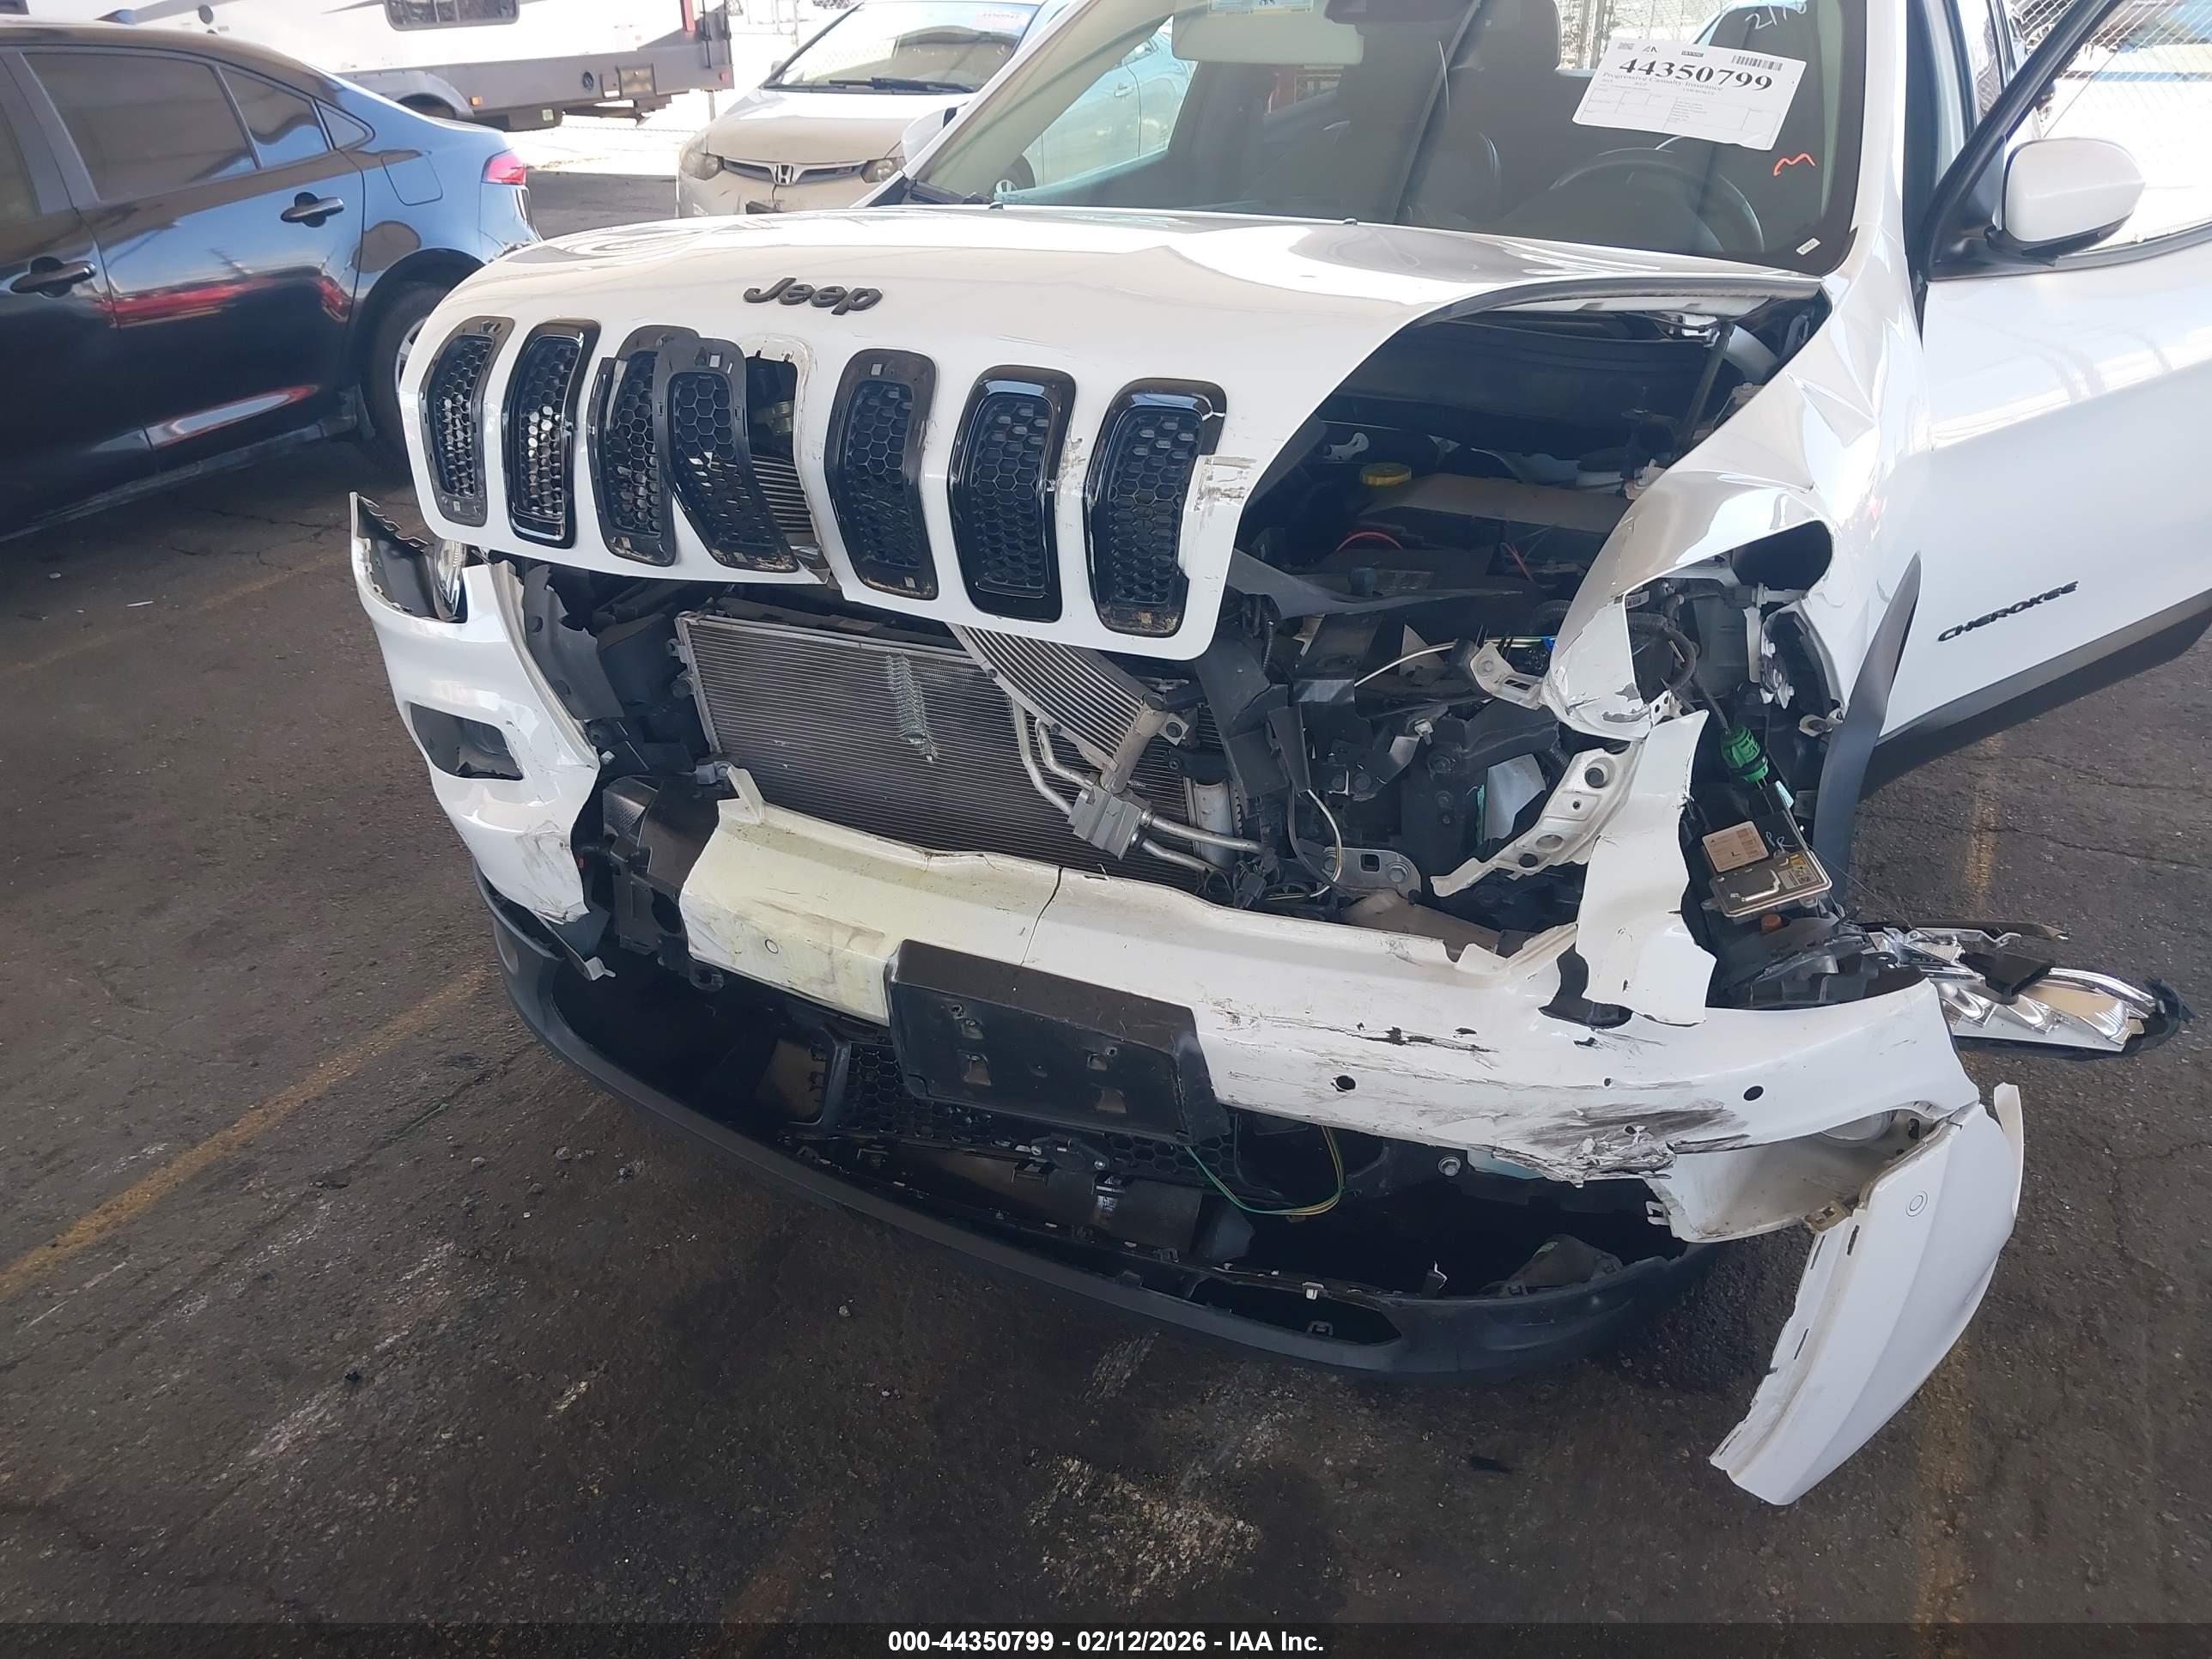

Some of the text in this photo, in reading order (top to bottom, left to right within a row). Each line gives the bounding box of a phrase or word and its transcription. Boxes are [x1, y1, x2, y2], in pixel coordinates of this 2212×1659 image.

[1619, 58, 1773, 92] 44350799
[743, 277, 883, 316] Jeep
[1937, 580, 2079, 641] CHEROKEE
